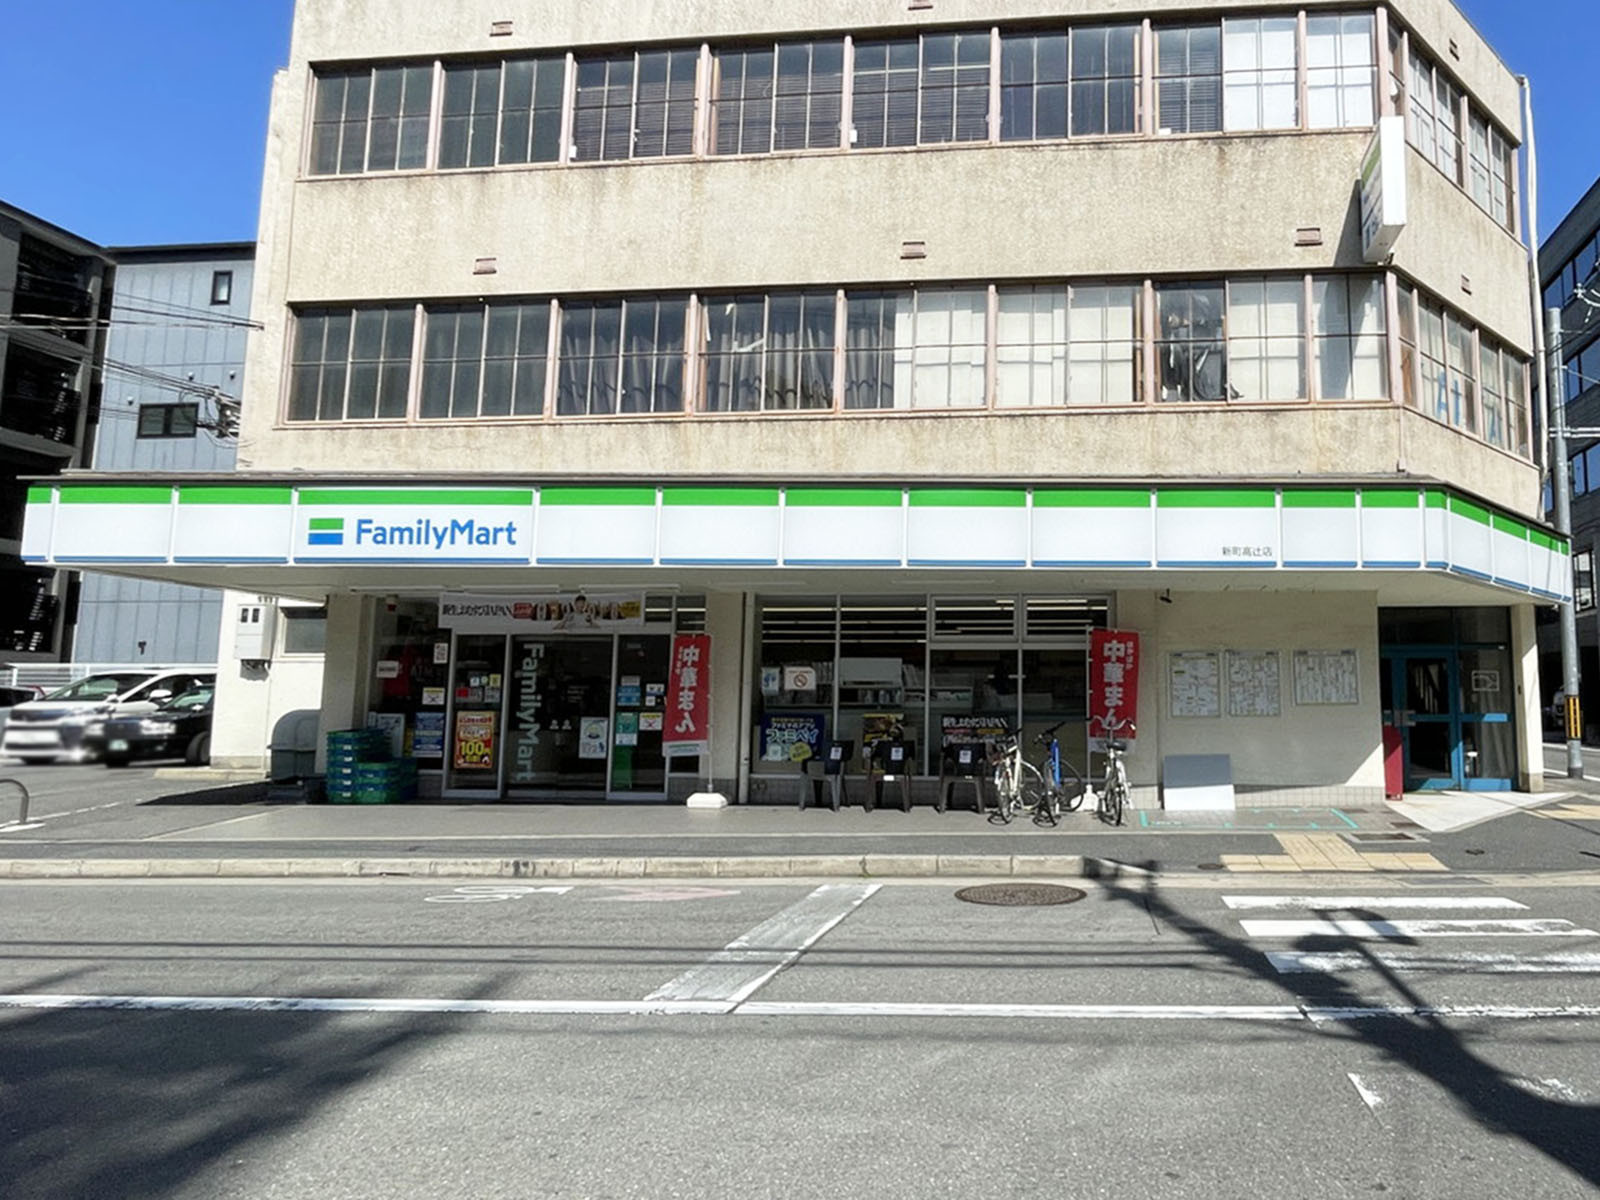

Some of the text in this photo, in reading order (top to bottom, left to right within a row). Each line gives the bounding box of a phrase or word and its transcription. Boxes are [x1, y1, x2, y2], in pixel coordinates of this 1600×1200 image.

[356, 518, 517, 549] FamilyMart
[1222, 546, 1272, 557] 新町高辻店
[516, 643, 544, 781] FamilyMart
[1102, 639, 1126, 729] 中華まん
